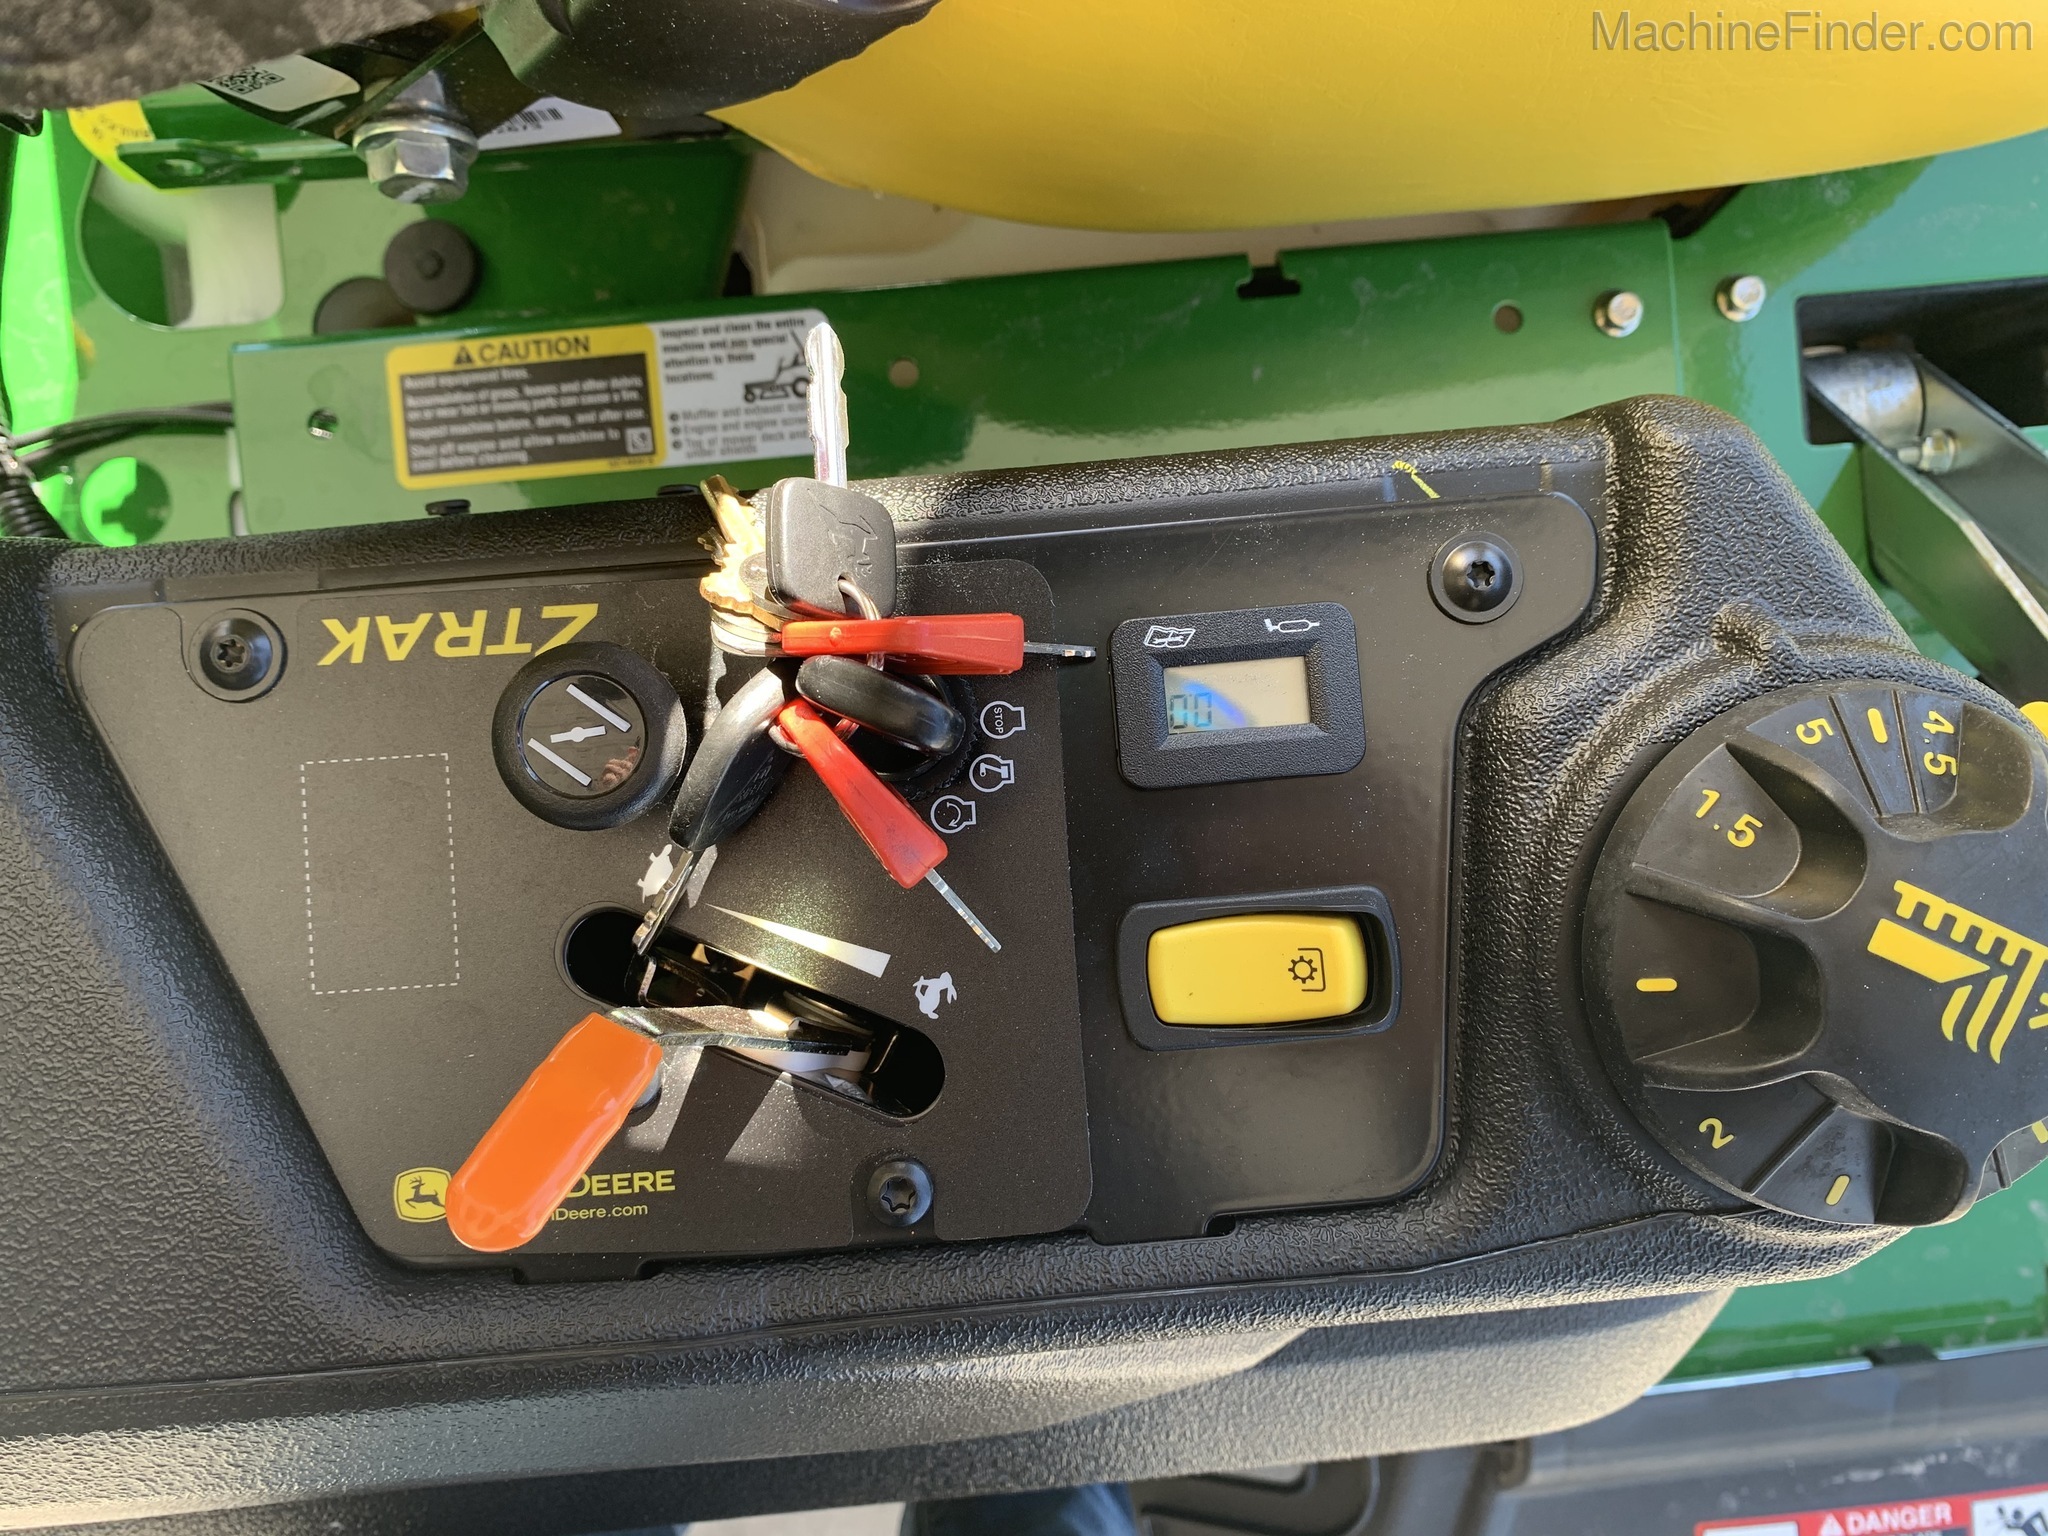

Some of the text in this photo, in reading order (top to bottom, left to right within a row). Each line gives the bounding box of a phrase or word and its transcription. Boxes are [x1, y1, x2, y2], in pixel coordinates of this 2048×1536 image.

[479, 335, 589, 363] CAUTION
[317, 603, 599, 666] ZTRAK
[994, 707, 1004, 734] STOP
[1796, 718, 1834, 745] 5
[1922, 710, 1957, 777] 4.5
[1695, 789, 1763, 849] 1.5
[1698, 1117, 1736, 1150] 2
[1846, 1501, 1953, 1535] DANGER
